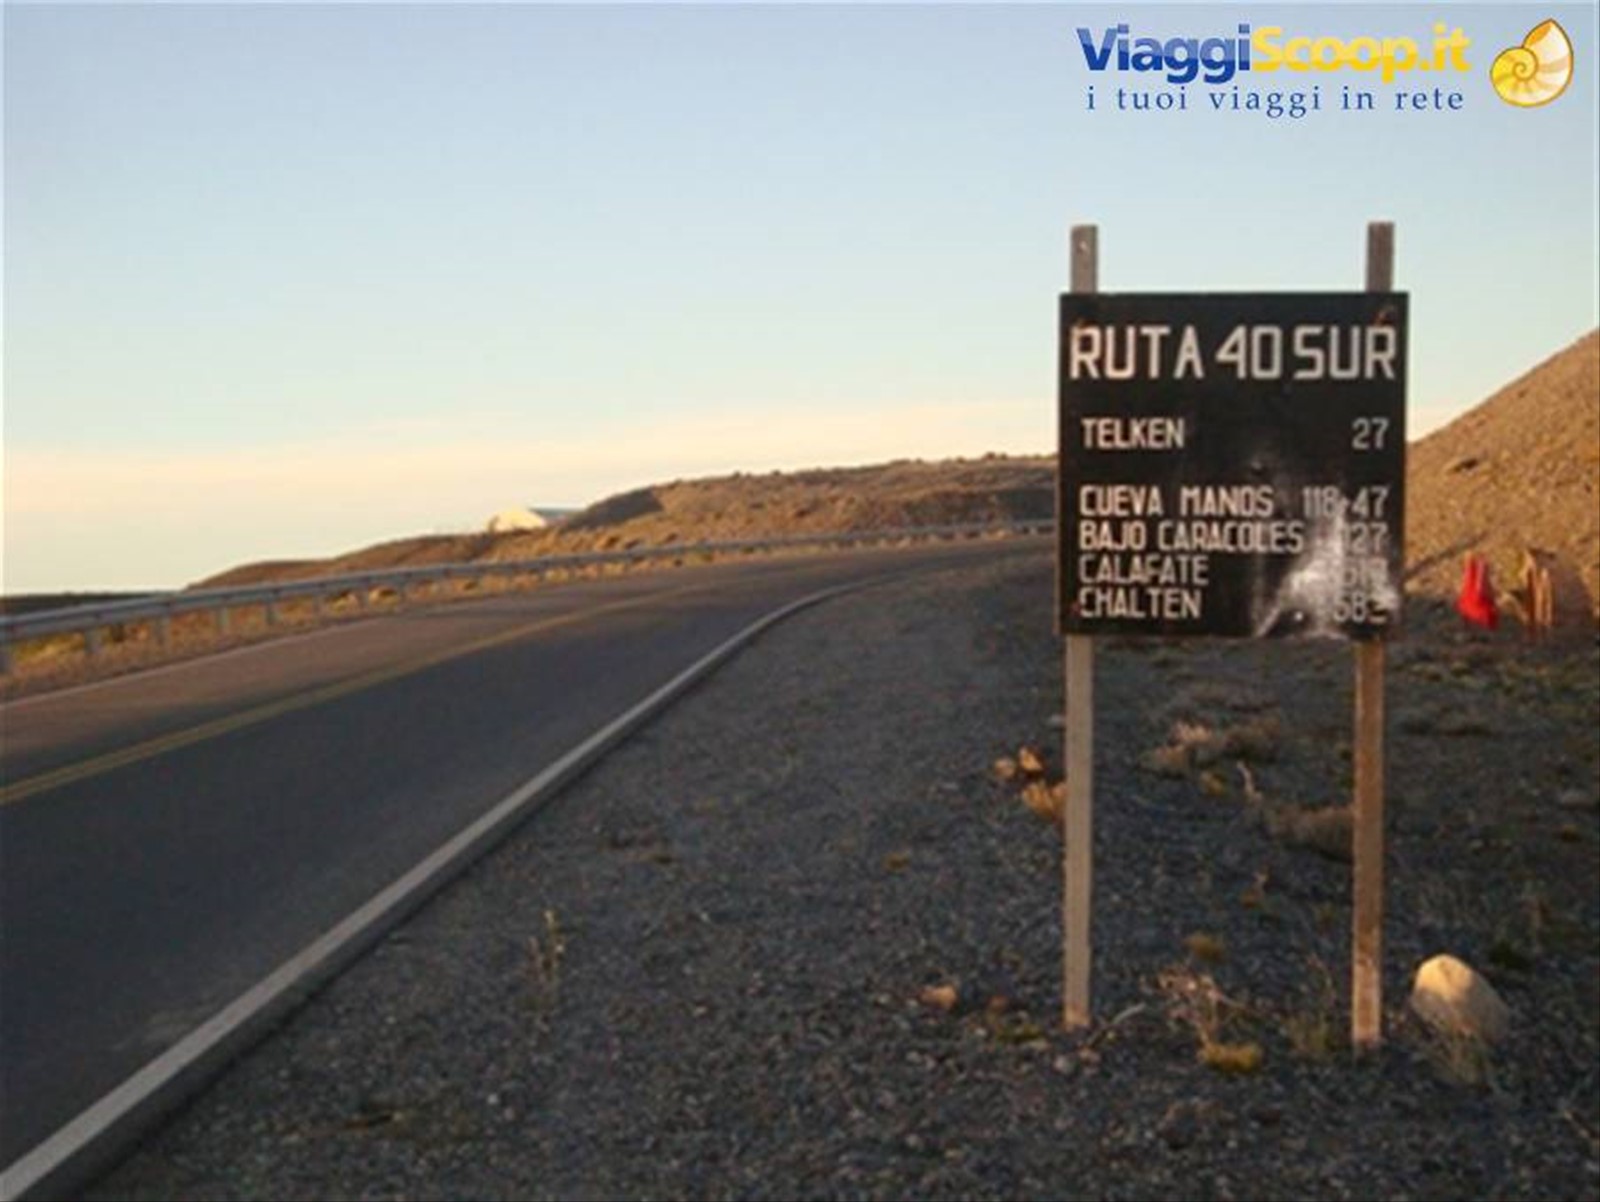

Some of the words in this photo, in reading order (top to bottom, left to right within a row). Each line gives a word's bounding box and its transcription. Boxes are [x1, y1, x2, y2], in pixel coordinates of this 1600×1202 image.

[1069, 325, 1204, 380] RUTA
[1216, 325, 1283, 380] 40
[1293, 325, 1397, 380] SUR
[1081, 418, 1185, 449] TELKEN
[1352, 418, 1389, 449] 27
[1080, 486, 1163, 517] CUEVA
[1180, 486, 1274, 517] MANOS
[1080, 521, 1146, 551] BAJO
[1158, 521, 1304, 553] CARACOLES
[1079, 555, 1209, 585] CALAFATE
[1080, 588, 1201, 619] CHALTEN
